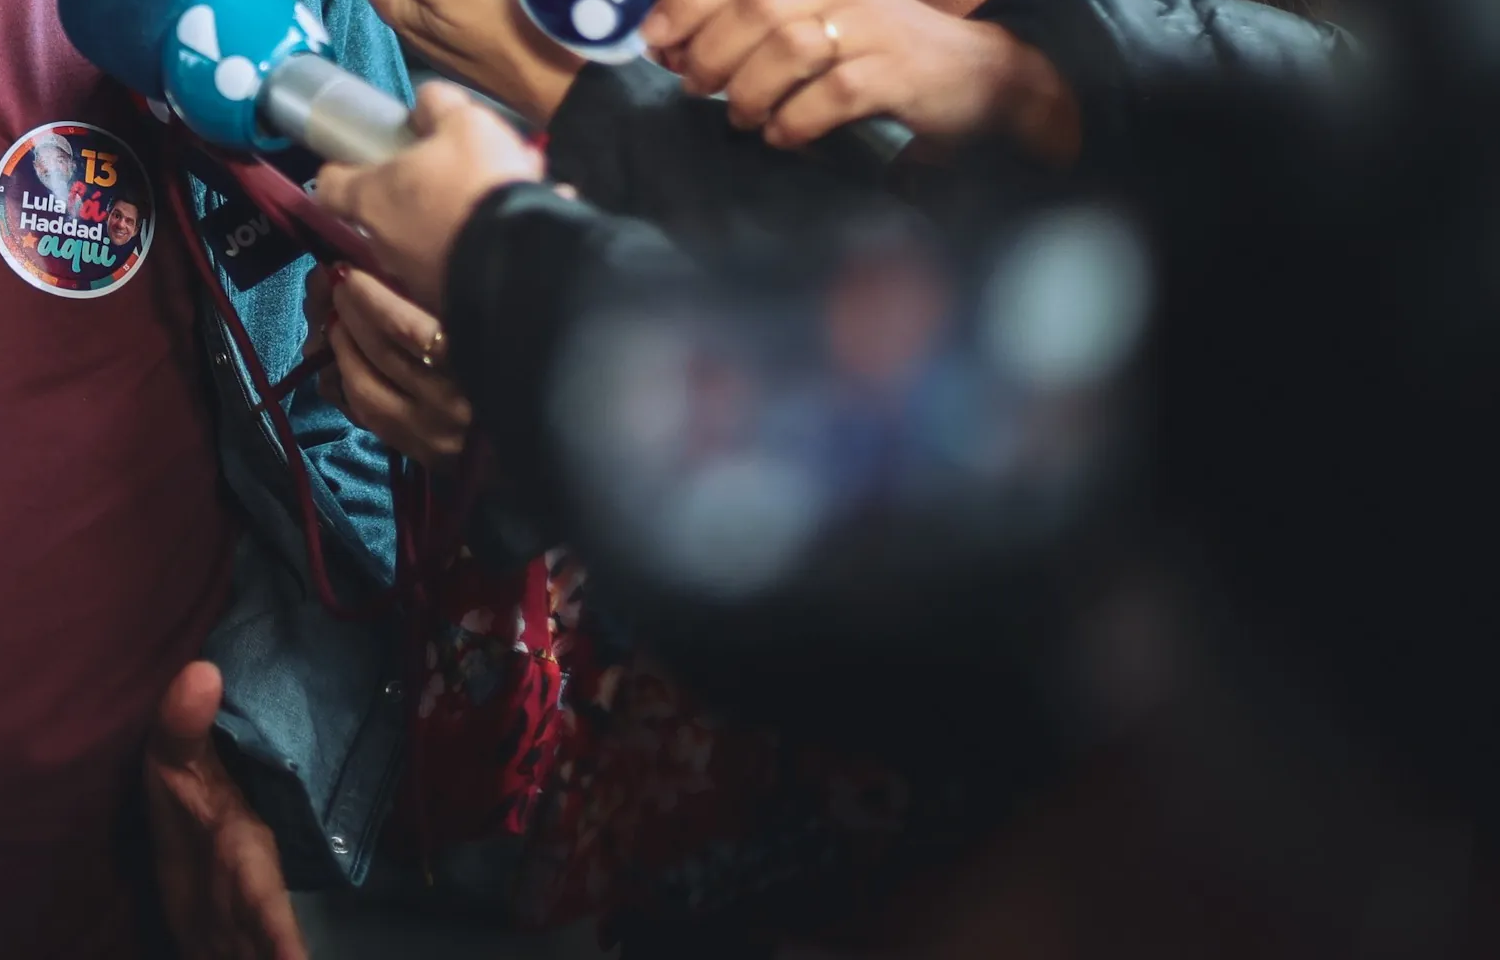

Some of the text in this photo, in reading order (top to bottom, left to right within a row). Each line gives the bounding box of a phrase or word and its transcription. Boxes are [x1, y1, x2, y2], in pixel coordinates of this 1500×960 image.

[81, 149, 118, 188] 13
[22, 191, 67, 215] Lula
[20, 212, 103, 242] Haddad
[225, 213, 271, 257] JOV
[37, 234, 117, 273] aqui
